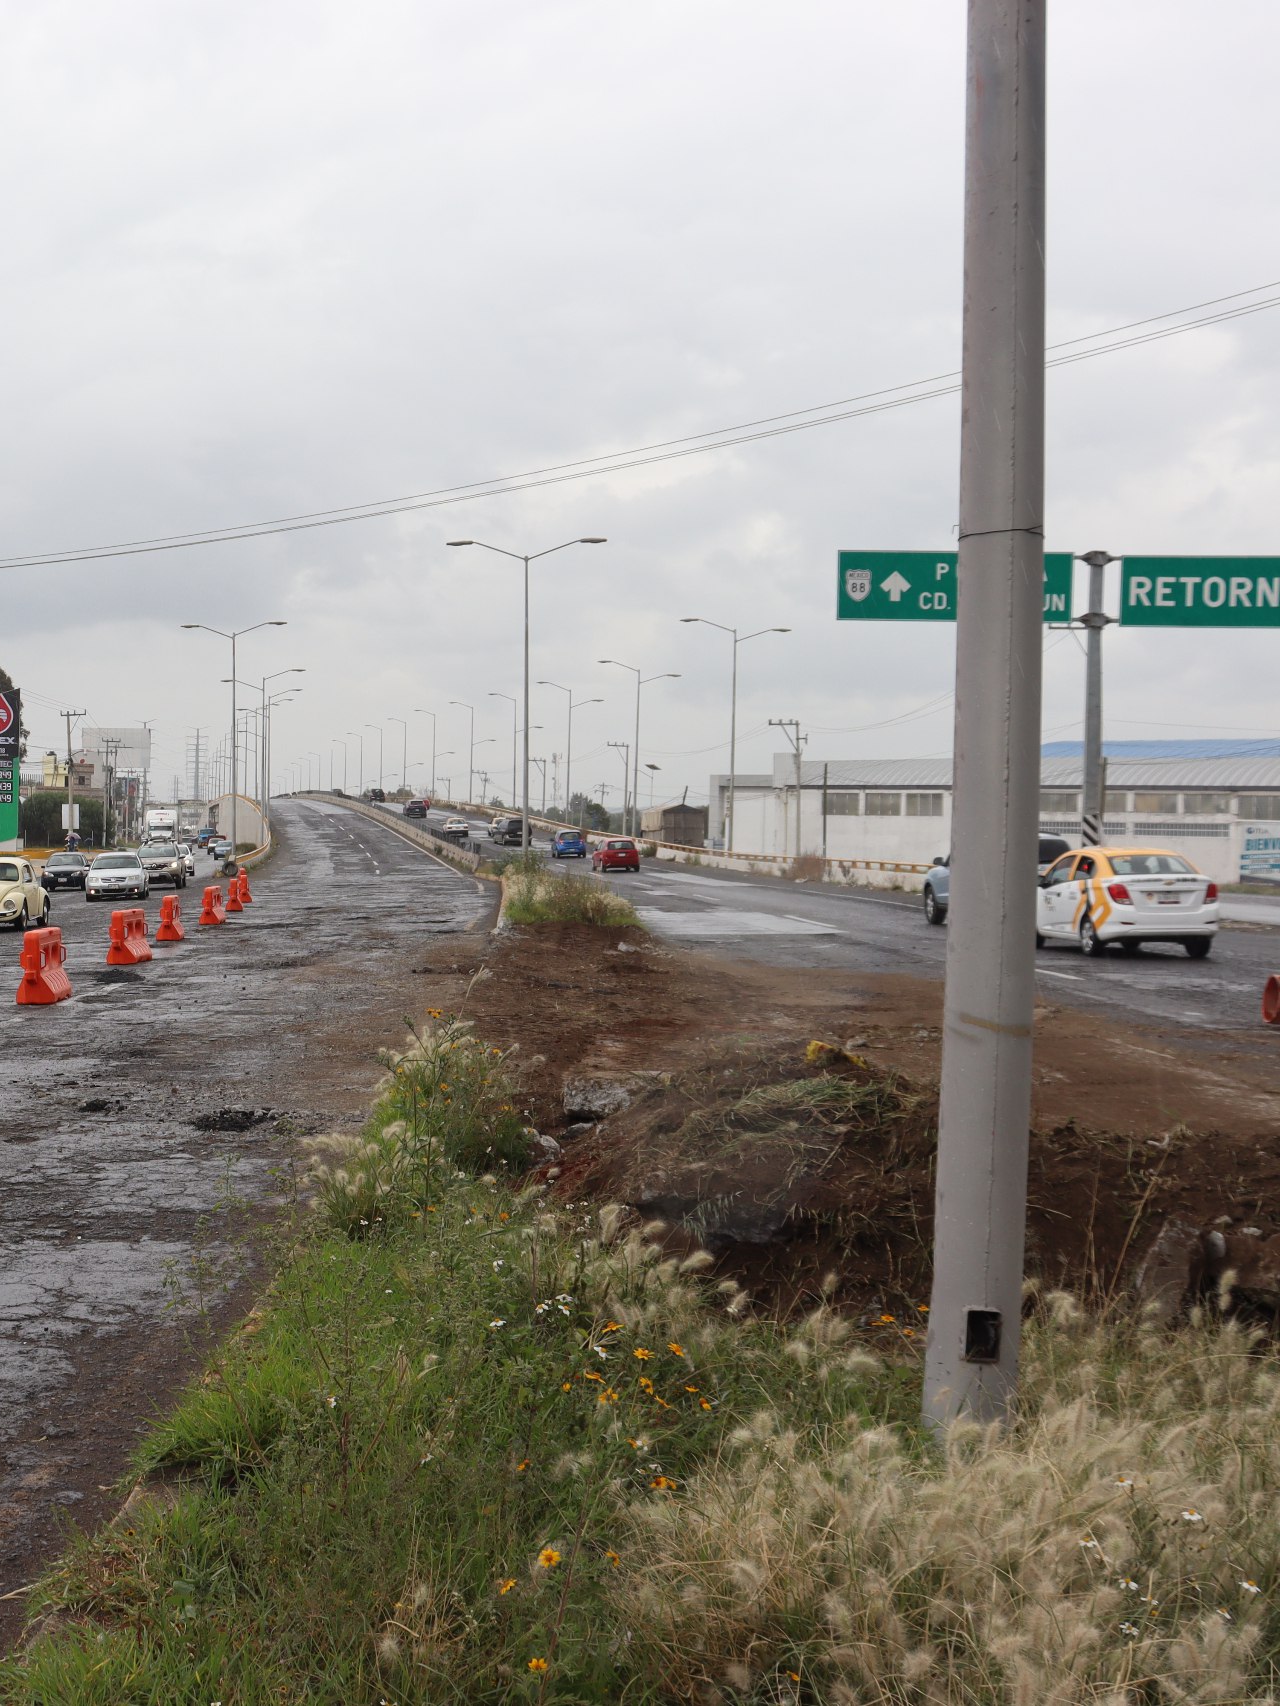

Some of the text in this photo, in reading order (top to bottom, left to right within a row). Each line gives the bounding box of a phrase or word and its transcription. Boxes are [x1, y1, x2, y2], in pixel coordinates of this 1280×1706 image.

[851, 582, 866, 593] 88
[1128, 576, 1280, 608] RETORN
[919, 591, 951, 610] CD.
